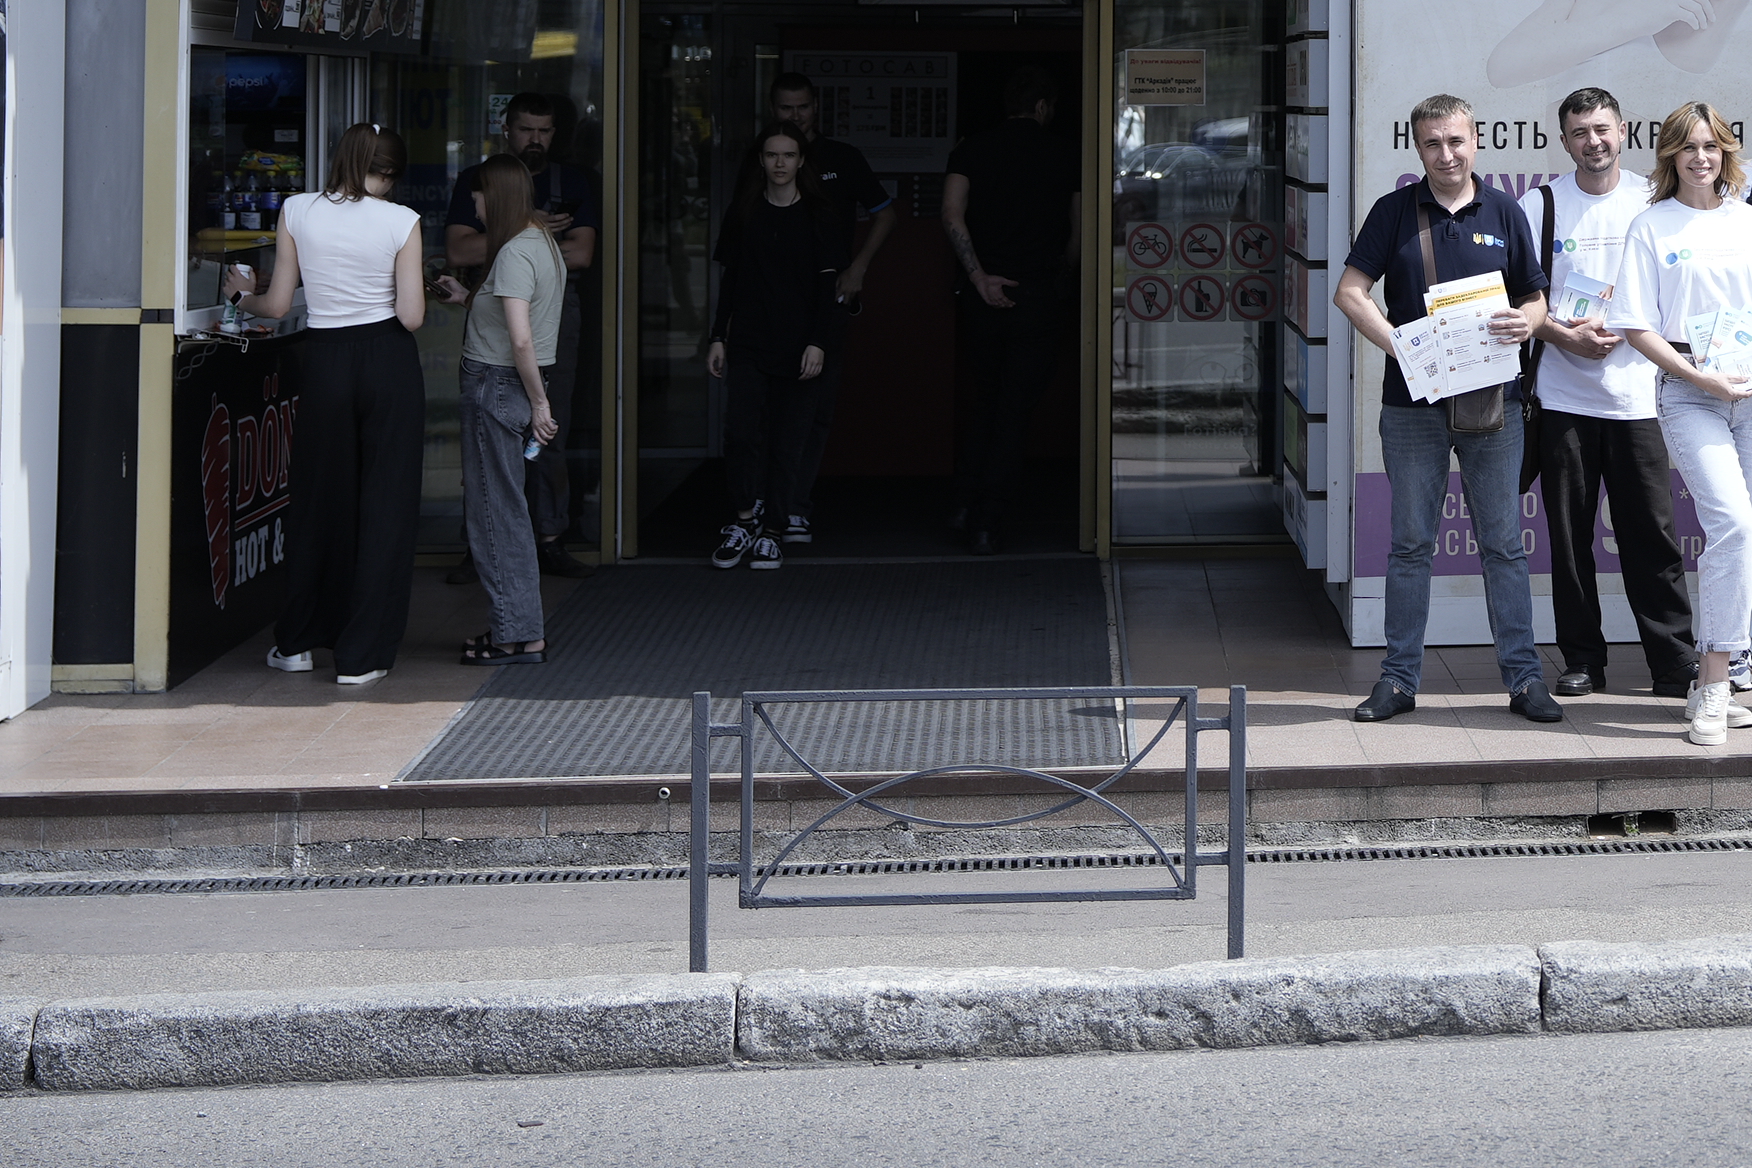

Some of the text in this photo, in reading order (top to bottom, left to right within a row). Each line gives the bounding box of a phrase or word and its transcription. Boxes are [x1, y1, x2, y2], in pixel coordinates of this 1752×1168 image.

[803, 59, 935, 74] FOTOCAB
[229, 77, 264, 89] pepsi
[1476, 121, 1549, 151] ЕСТЬ
[235, 517, 285, 587] HOT &
